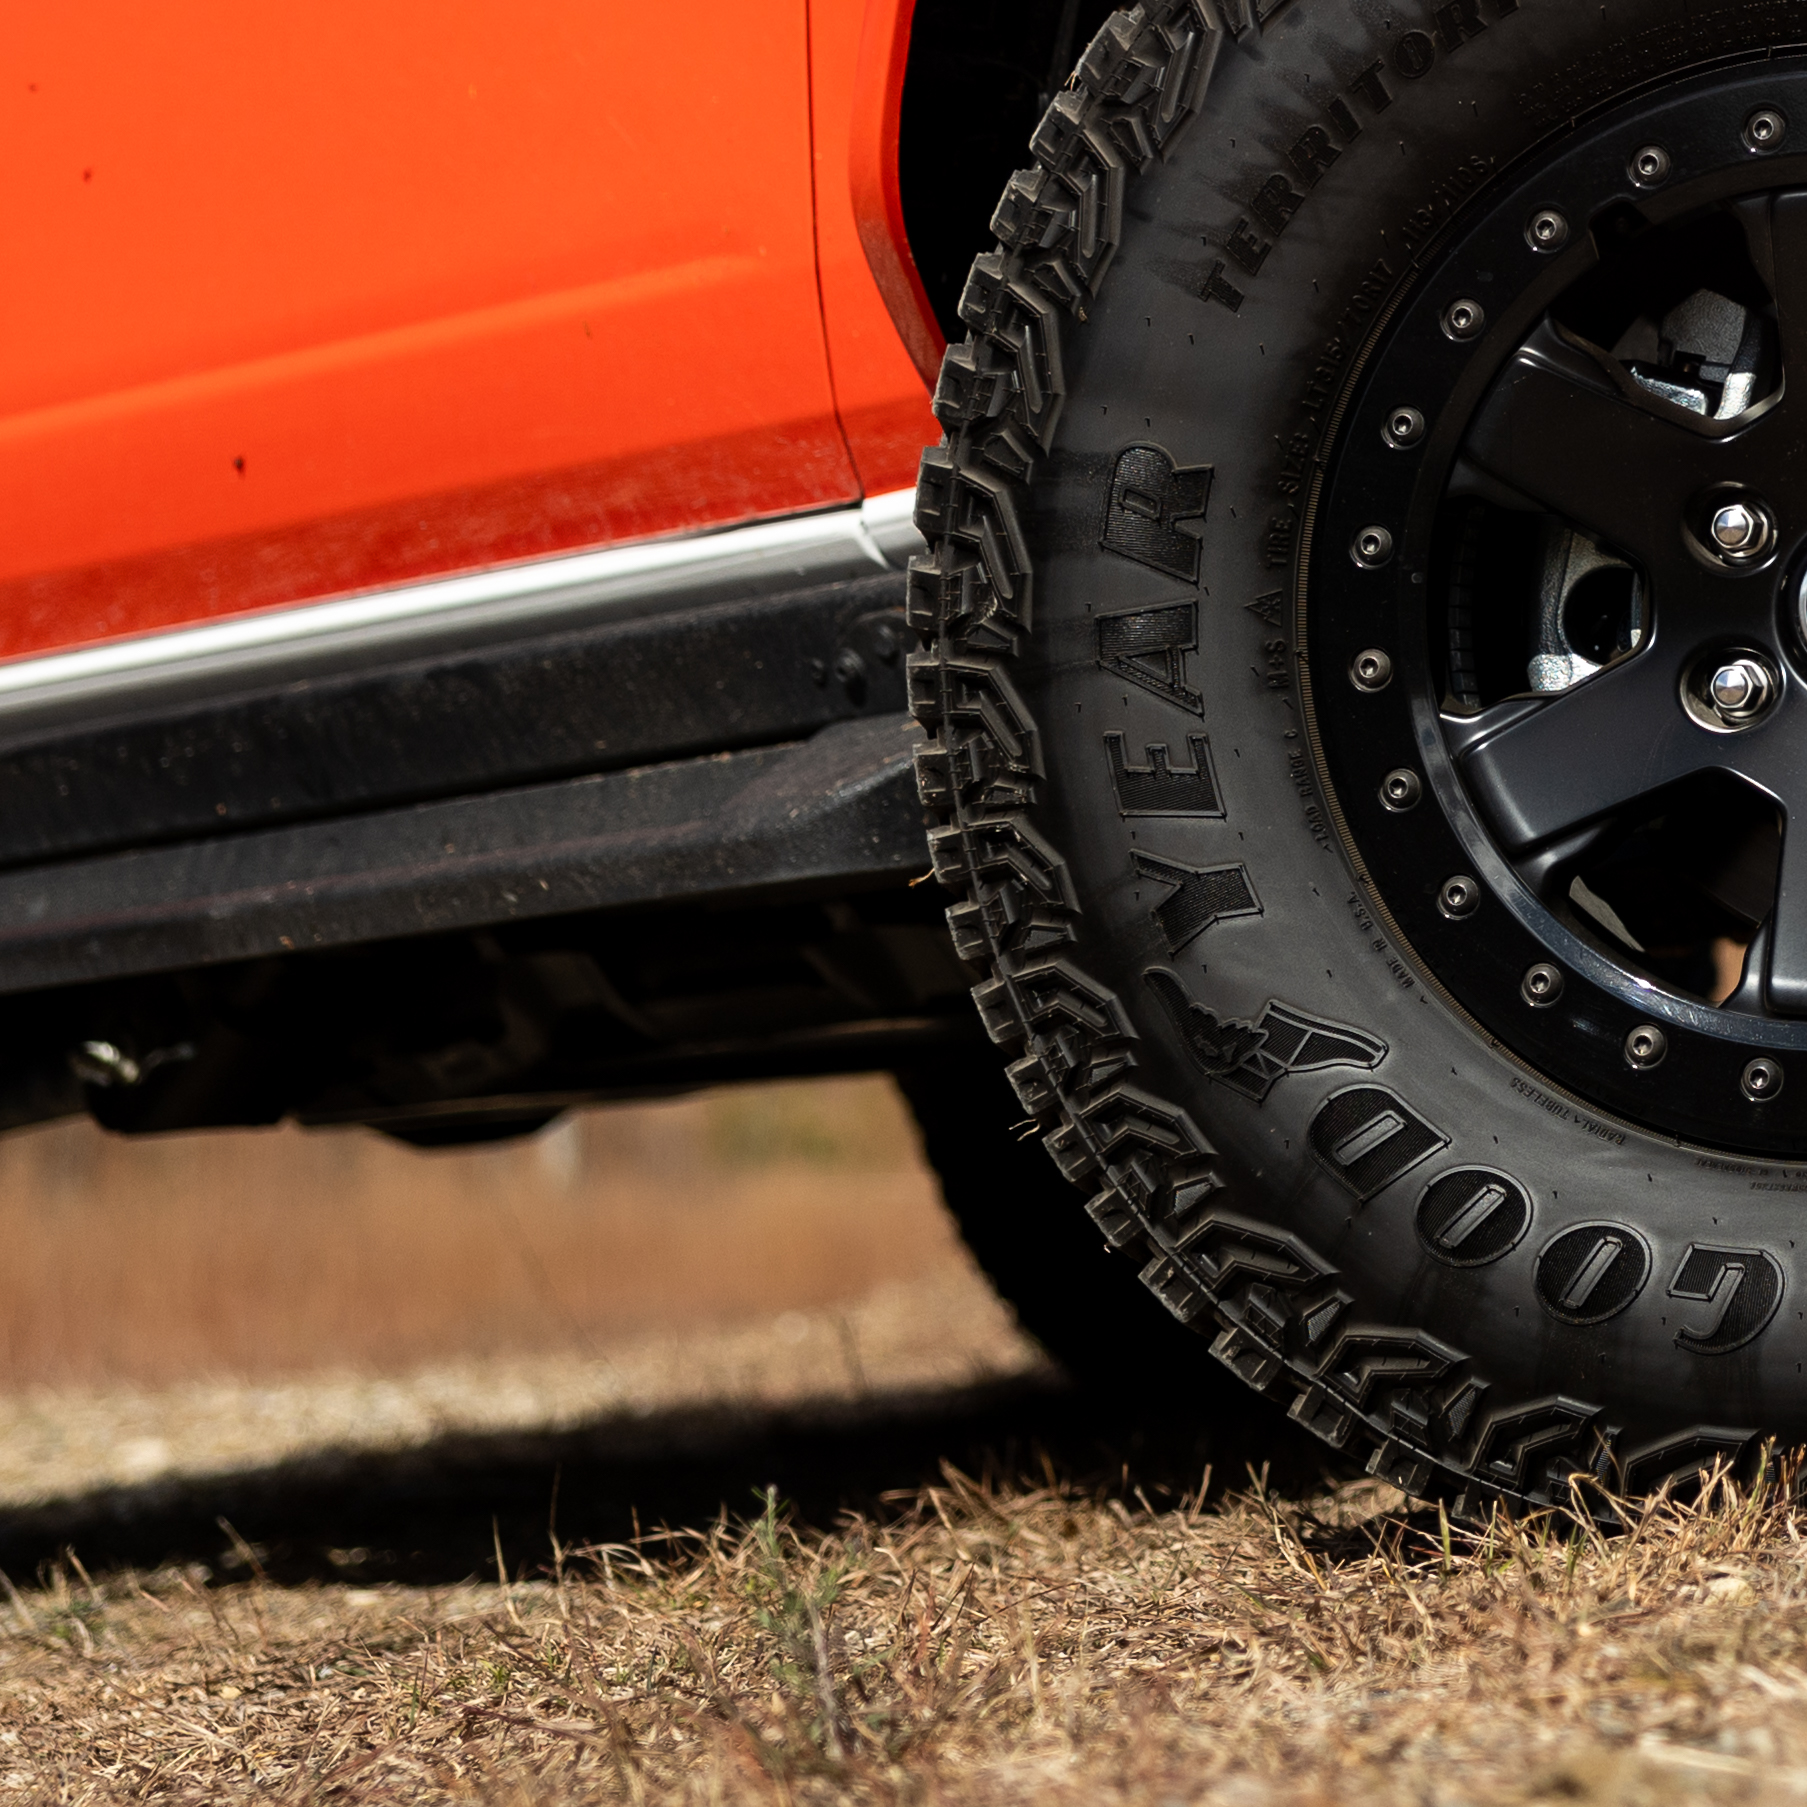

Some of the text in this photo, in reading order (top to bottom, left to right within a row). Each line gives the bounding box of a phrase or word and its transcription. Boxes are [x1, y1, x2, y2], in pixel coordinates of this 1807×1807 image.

[1263, 639, 1290, 692] M+S
[1510, 1074, 1625, 1147] RADIAL TUBELESS
